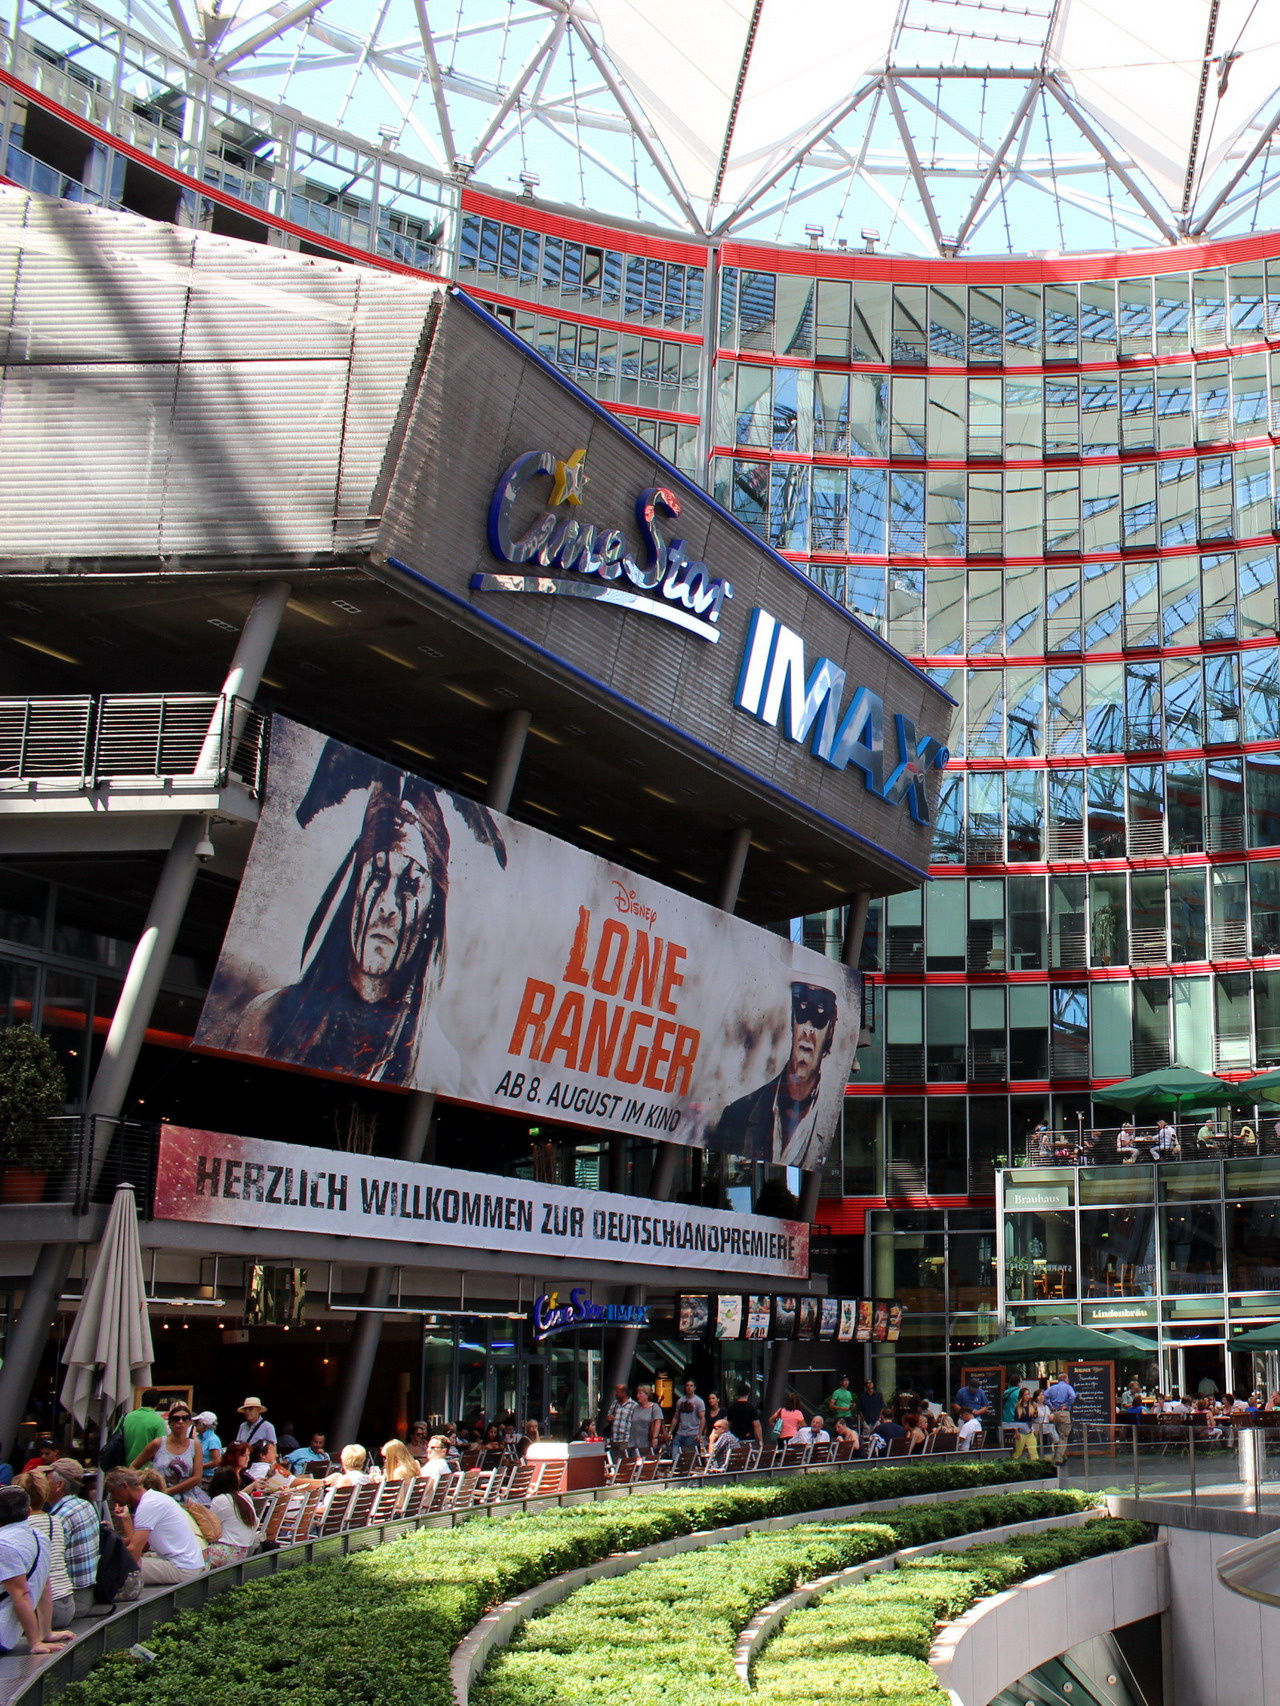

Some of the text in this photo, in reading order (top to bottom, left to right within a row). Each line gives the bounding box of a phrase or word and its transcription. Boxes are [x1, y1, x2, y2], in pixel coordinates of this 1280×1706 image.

[488, 450, 931, 827] CineStar IMAX
[562, 904, 687, 1016] LONE
[507, 977, 701, 1097] RANGER
[495, 1070, 681, 1132] AB 8. AUGUST IM KINO
[196, 1156, 795, 1261] HERZLICH WILLKOMMEN ZUR DEUTSCHLANDPREMIERE
[1014, 1193, 1060, 1204] Brauhaus
[1092, 1308, 1148, 1319] Lindenbräu
